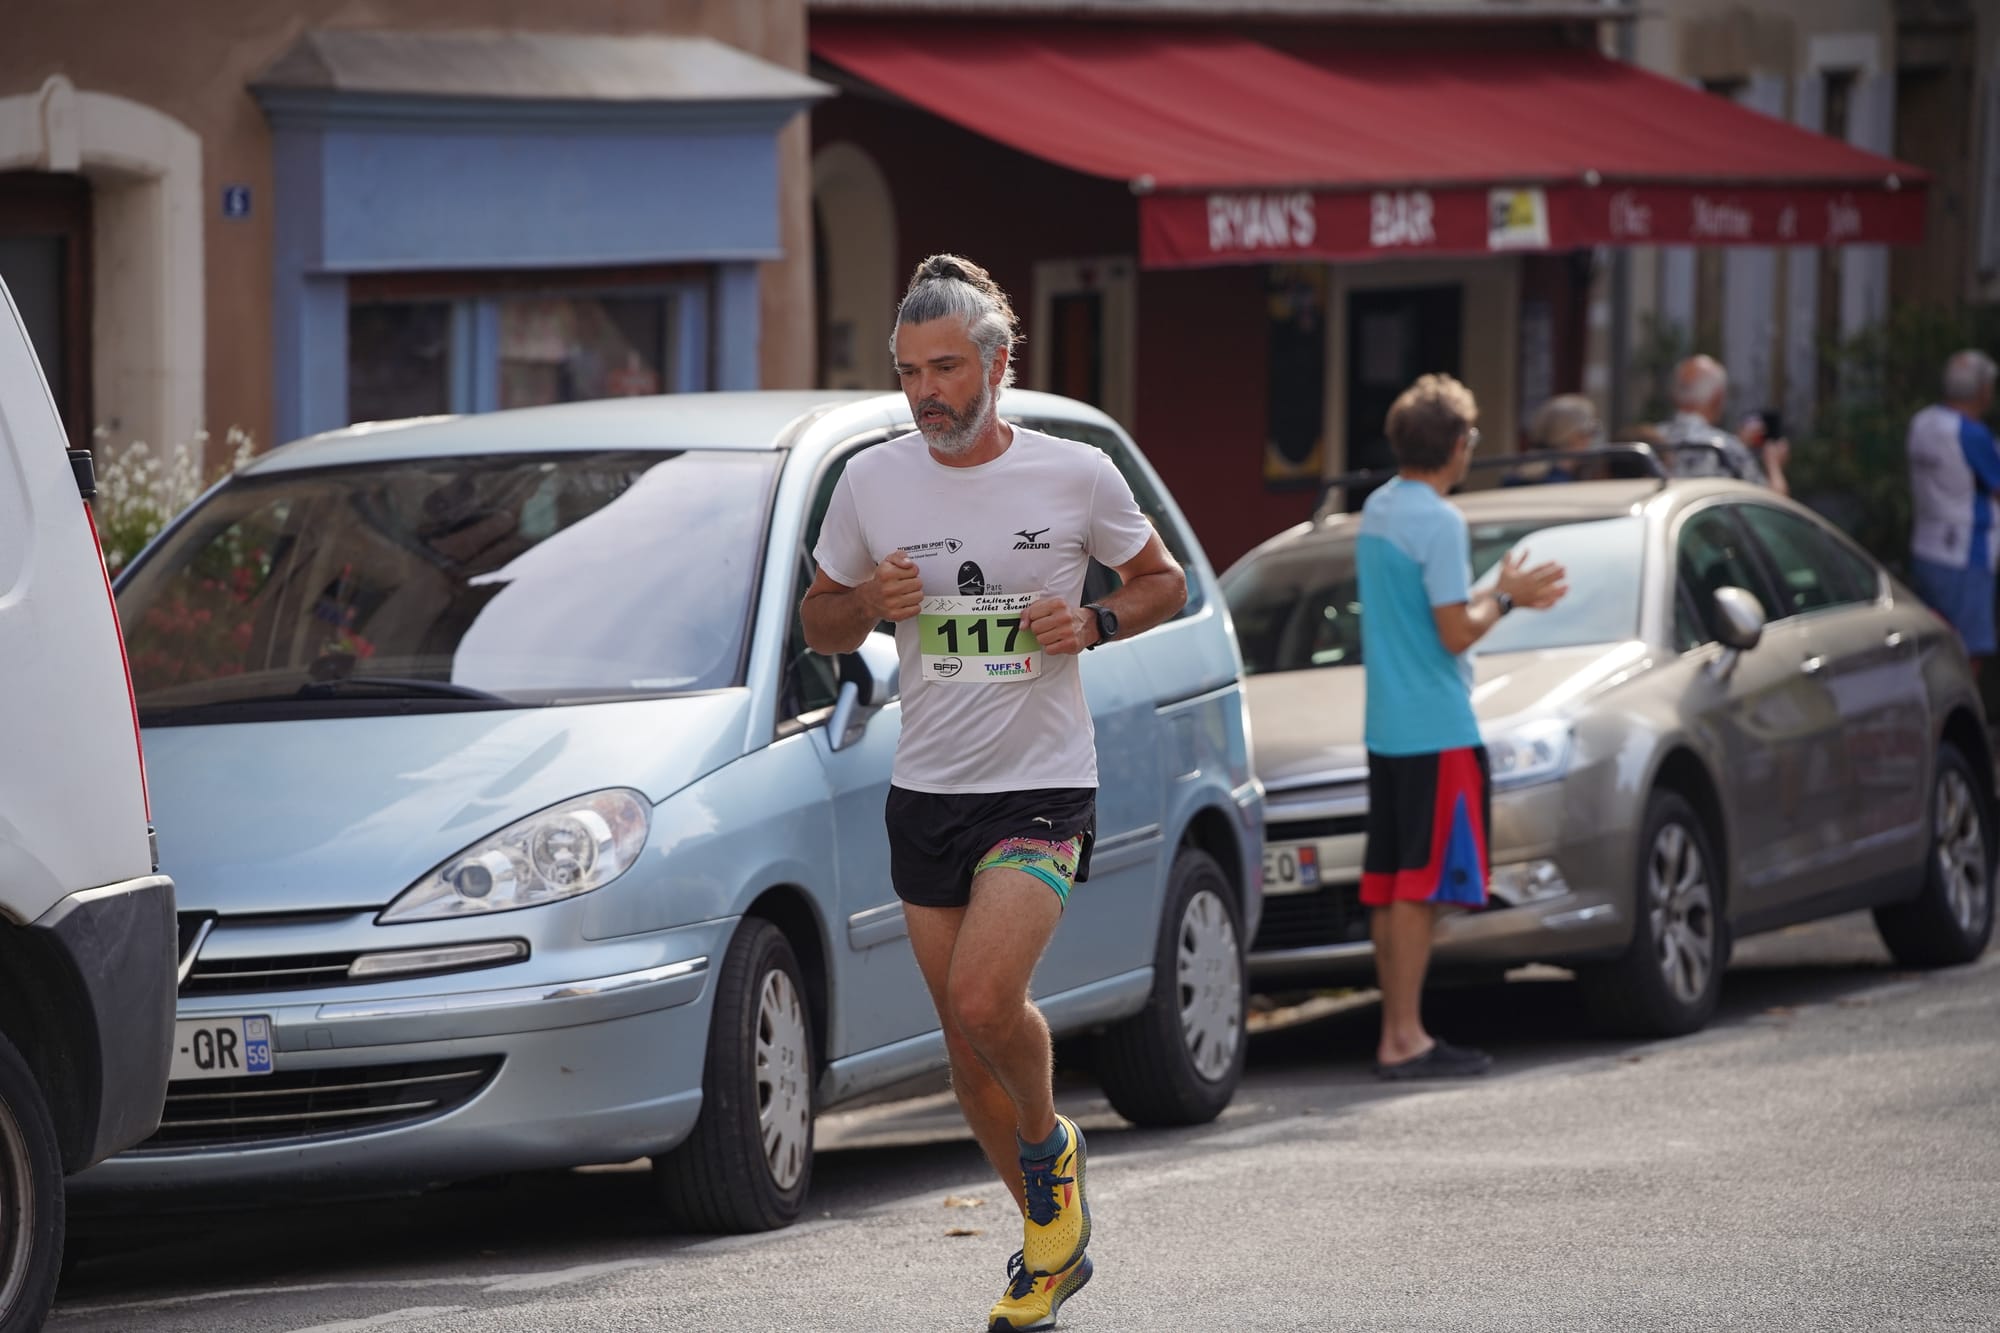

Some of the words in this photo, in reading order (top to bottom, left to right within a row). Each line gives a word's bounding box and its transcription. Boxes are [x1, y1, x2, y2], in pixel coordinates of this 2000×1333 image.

[1207, 191, 1315, 250] RYAN'S
[1369, 191, 1436, 247] BAR
[975, 597, 1015, 606] Challenge
[937, 619, 1022, 653] 117
[933, 663, 959, 671] BFP
[984, 662, 1022, 671] TUFF'S
[247, 1045, 268, 1065] 59
